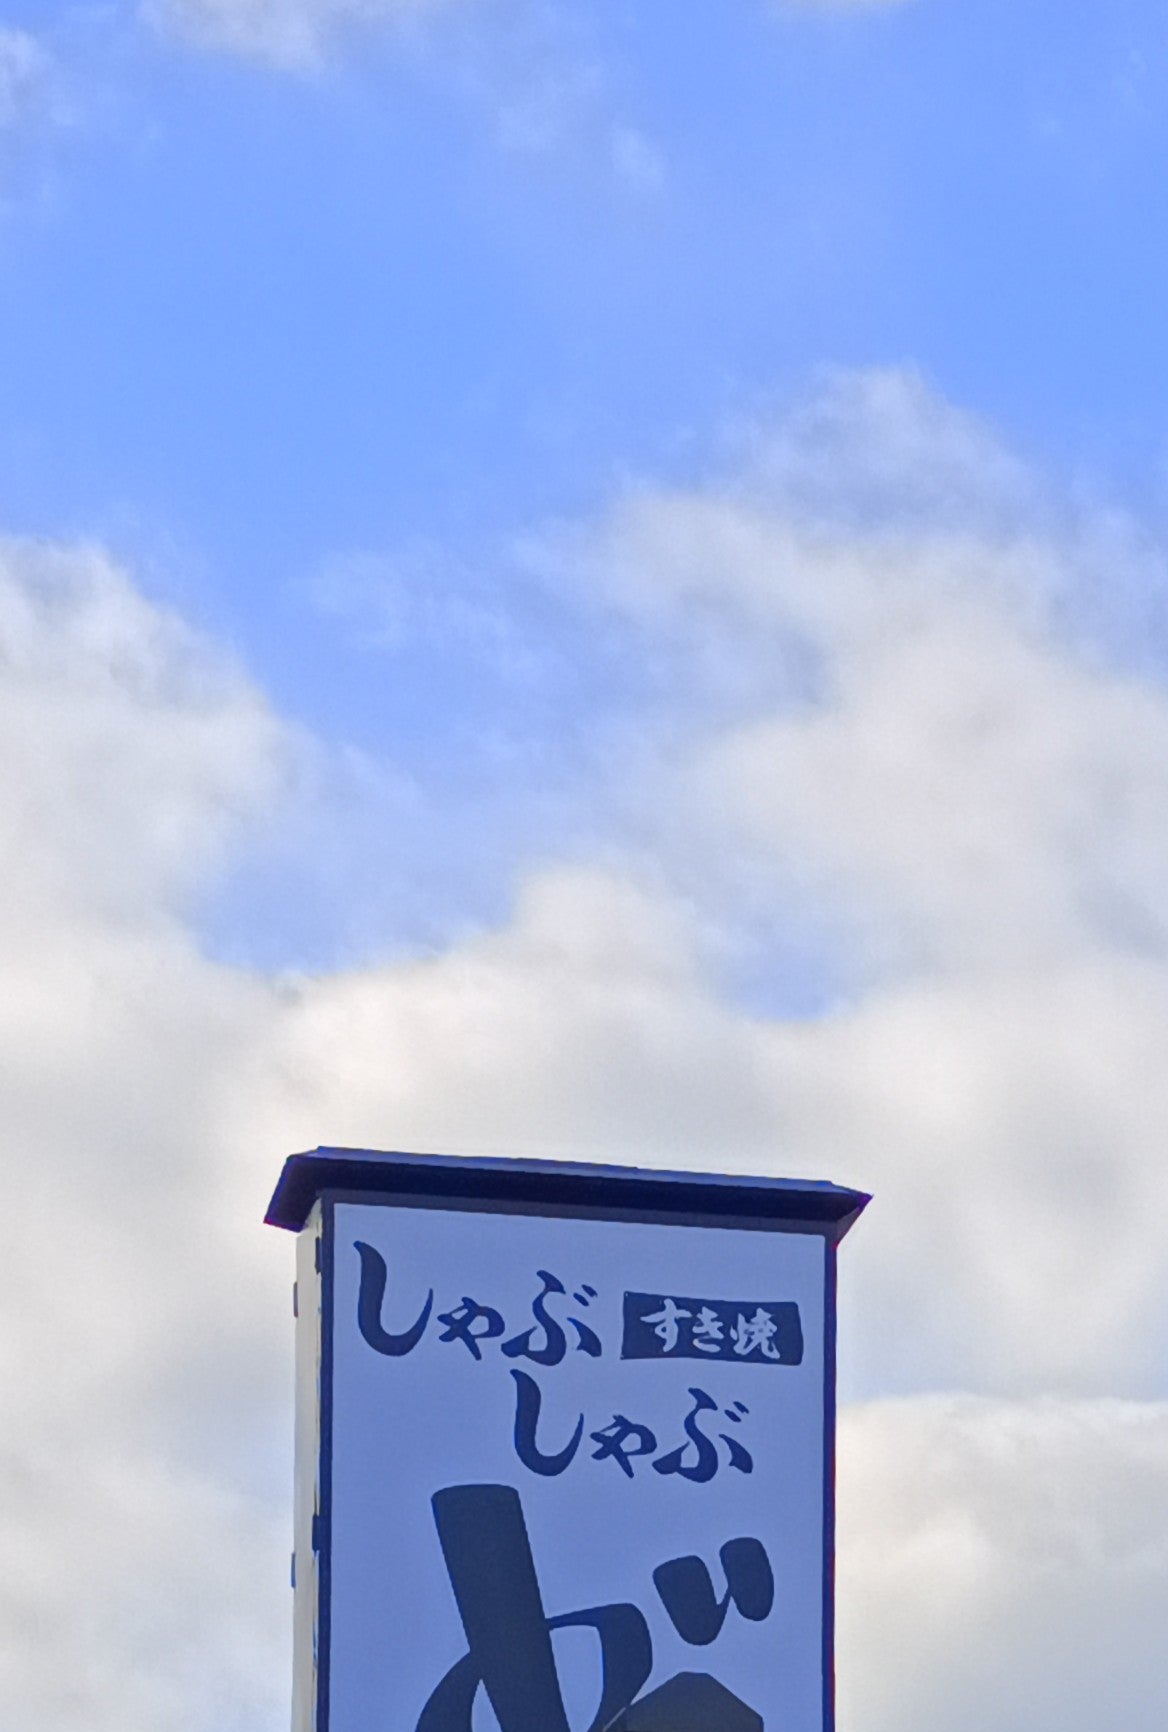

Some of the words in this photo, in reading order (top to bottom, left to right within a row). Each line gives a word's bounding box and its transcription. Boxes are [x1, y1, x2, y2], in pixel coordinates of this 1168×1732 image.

[353, 1240, 603, 1366] しゃぶ
[639, 1298, 782, 1361] すき焼
[510, 1369, 755, 1483] しゃぶ
